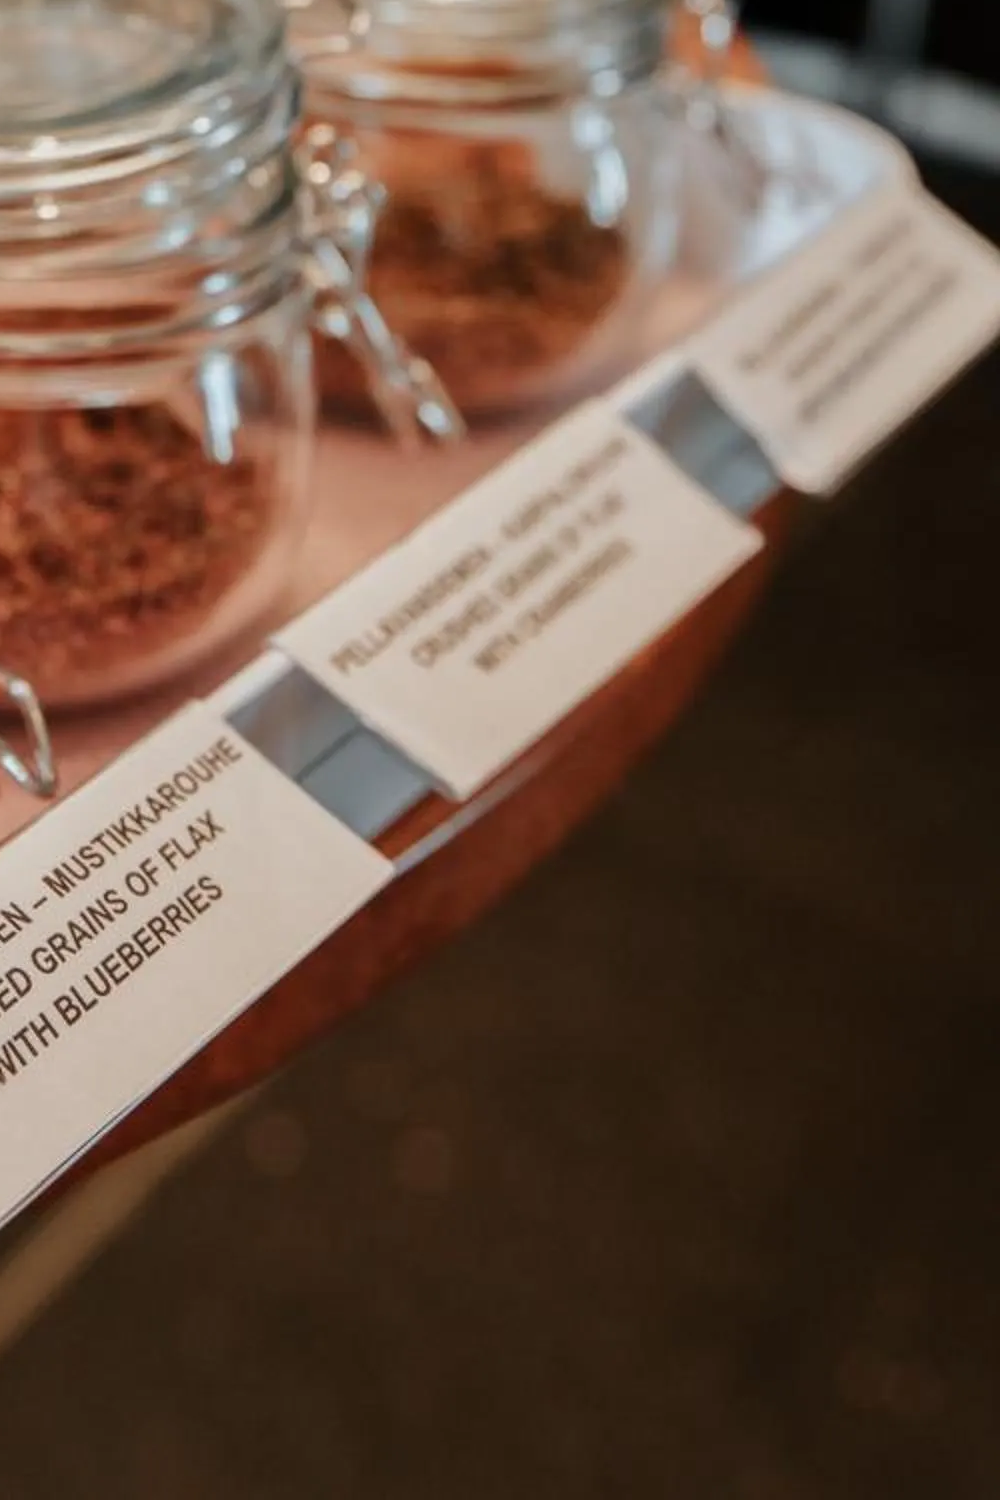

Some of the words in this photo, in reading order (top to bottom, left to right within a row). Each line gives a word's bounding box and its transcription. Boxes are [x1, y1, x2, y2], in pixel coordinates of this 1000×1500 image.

[30, 888, 128, 975] GRAINS
[125, 857, 160, 898] OF
[158, 810, 224, 871] FLAX
[42, 738, 243, 898] MUSTIKKAROUHE
[53, 876, 224, 1027] BLUEBERRIES
